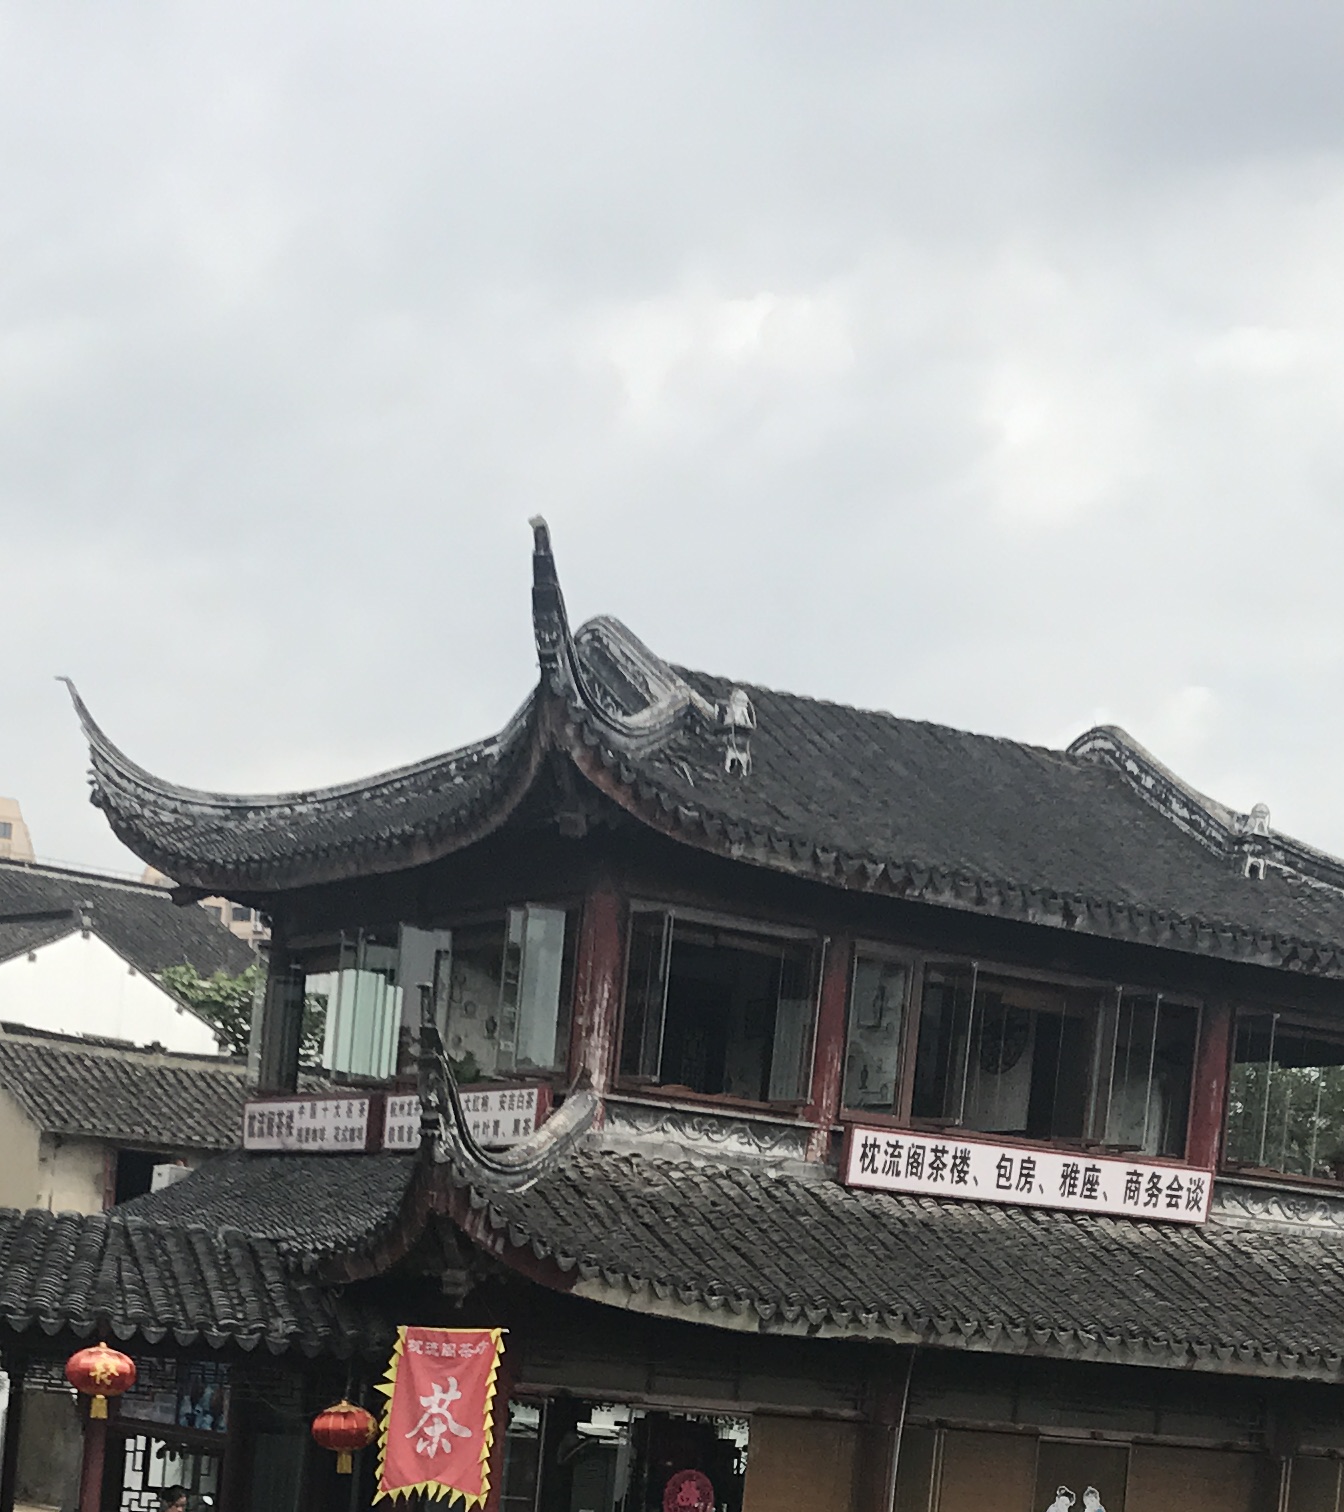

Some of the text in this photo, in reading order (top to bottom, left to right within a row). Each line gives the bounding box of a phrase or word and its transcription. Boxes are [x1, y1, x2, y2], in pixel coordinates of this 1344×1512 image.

[859, 1134, 1205, 1213] 枕流阁茶楼、包房、雅座、商务会谈
[405, 1375, 473, 1459] 茶
